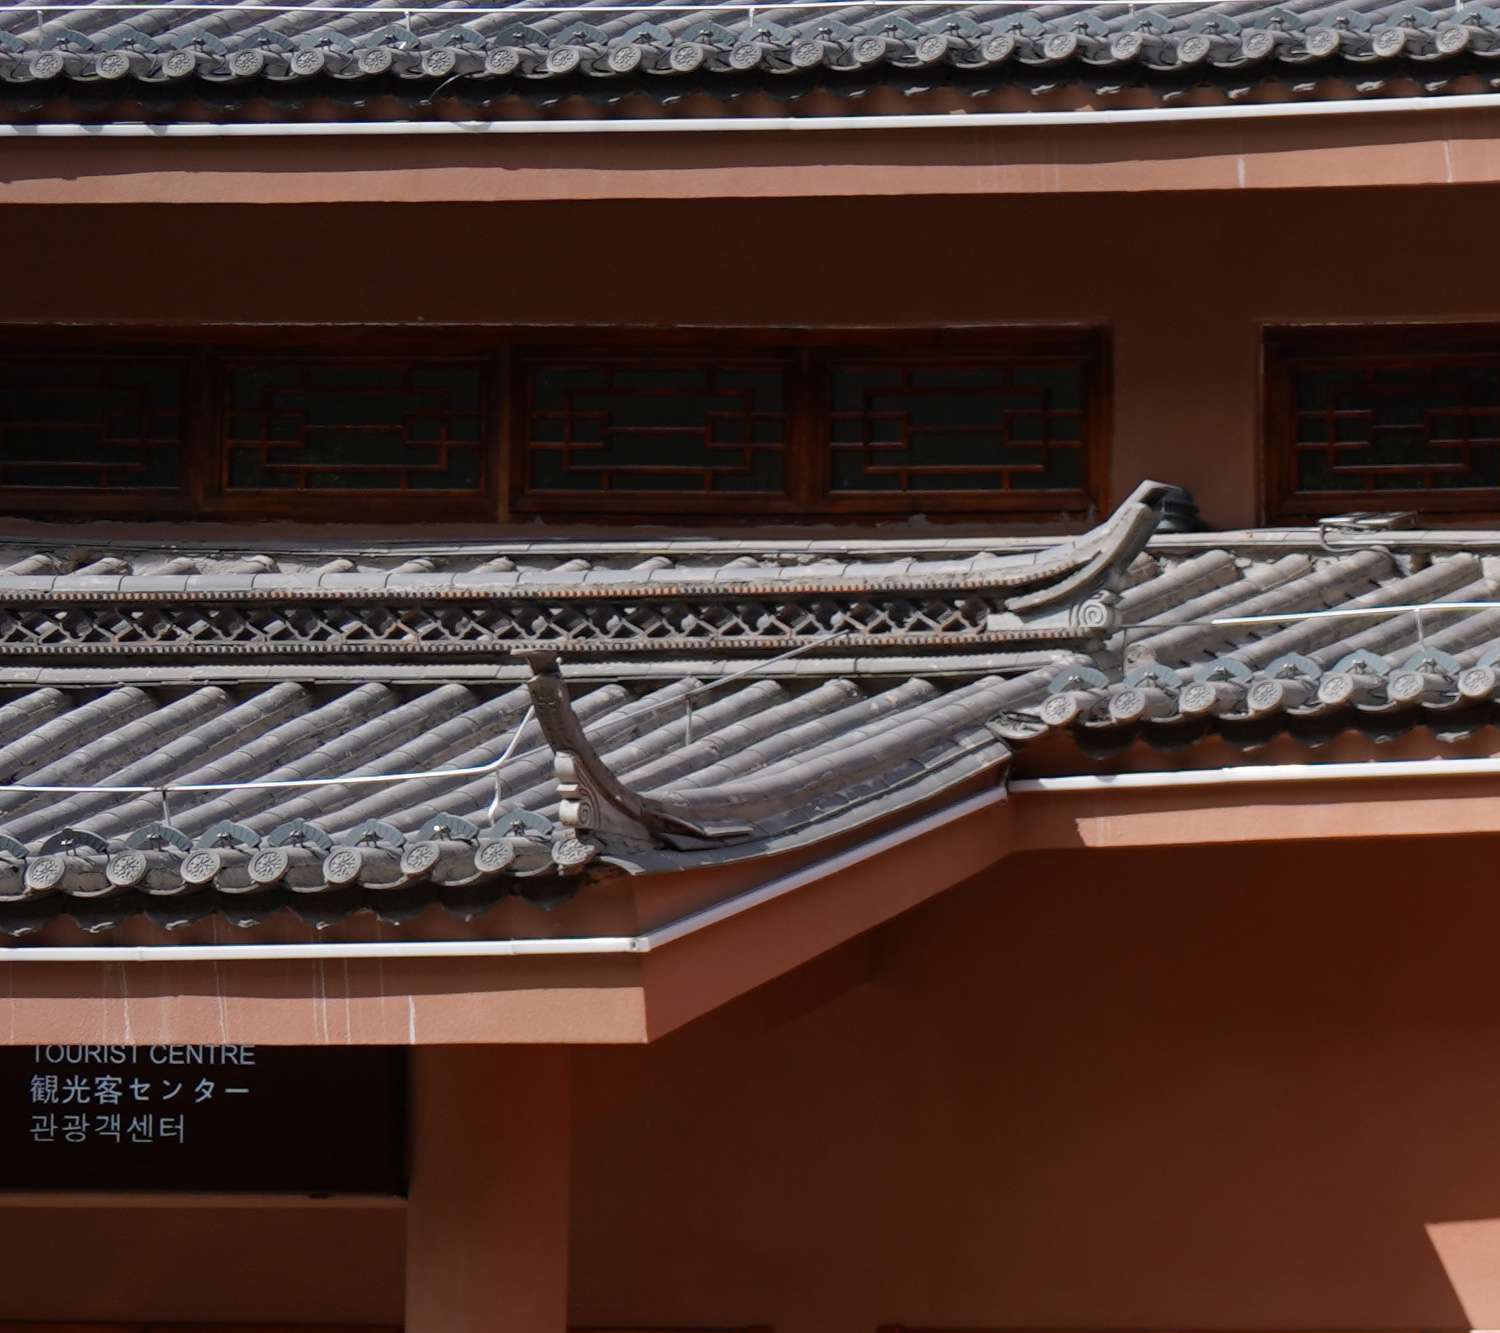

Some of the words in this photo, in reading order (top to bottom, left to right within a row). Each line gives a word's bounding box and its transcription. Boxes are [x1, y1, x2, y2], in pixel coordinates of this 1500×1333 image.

[34, 1044, 139, 1065] TOURIST
[150, 1044, 256, 1066] CENTRE
[30, 1074, 250, 1105] 観光客センター
[30, 1113, 186, 1144] 관광객센터
